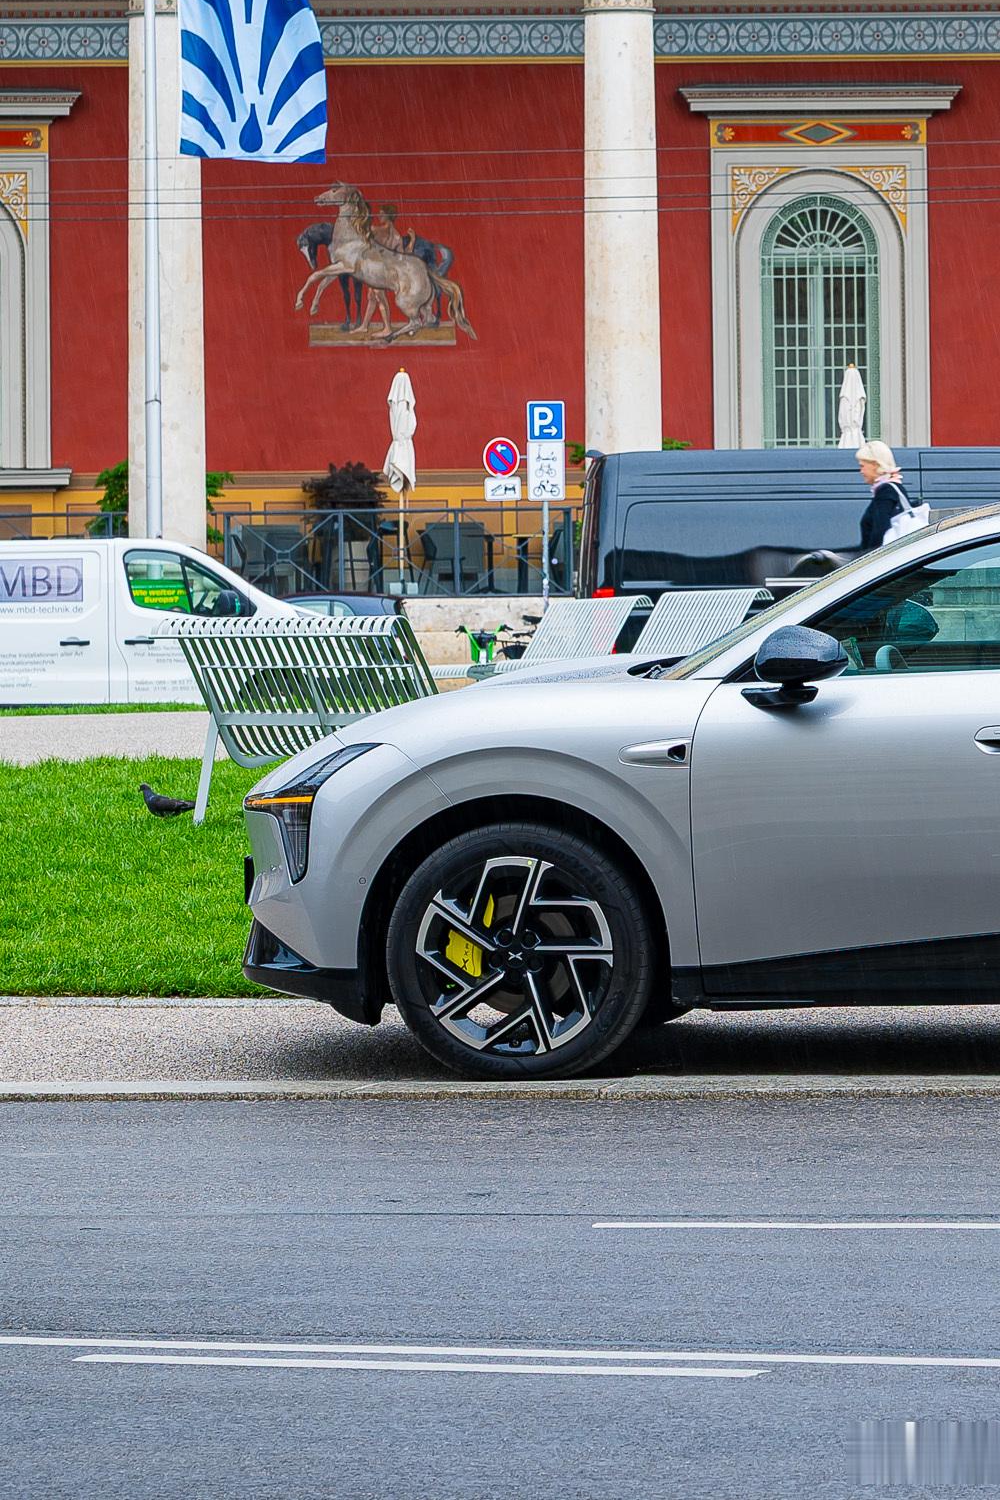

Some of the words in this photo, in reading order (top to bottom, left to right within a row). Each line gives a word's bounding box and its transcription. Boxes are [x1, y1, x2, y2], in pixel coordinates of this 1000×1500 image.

[533, 407, 553, 437] P
[0, 566, 83, 598] MBD
[144, 596, 179, 604] Europa?
[149, 589, 176, 597] weiter
